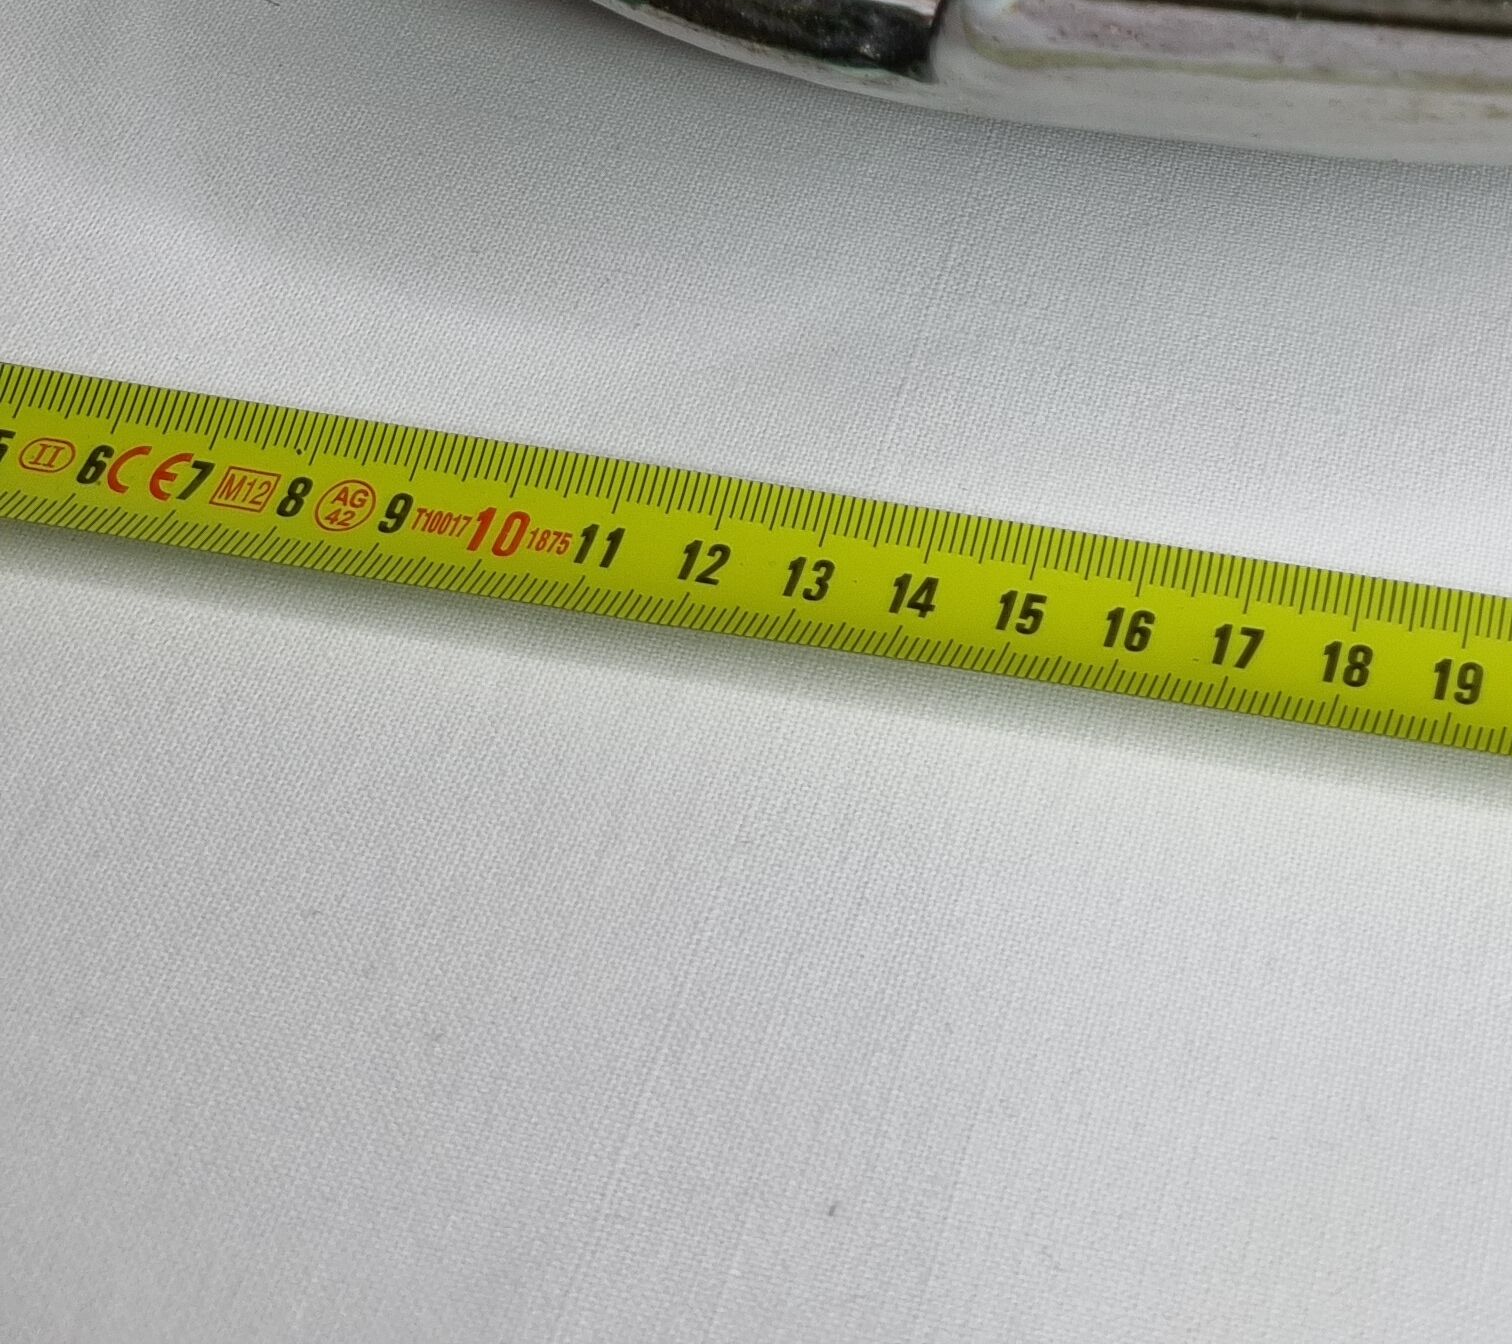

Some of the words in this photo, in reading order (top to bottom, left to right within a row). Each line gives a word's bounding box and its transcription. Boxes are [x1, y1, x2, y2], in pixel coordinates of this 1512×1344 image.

[218, 473, 272, 506] M12
[332, 486, 370, 509] AG
[324, 509, 356, 527] 42
[526, 527, 573, 555] 1875
[76, 444, 115, 485] 6
[176, 459, 216, 501] 7
[276, 476, 314, 518] 8
[378, 492, 414, 534] 9
[466, 506, 531, 558] 10
[573, 523, 626, 569] 11
[677, 539, 731, 586] 12
[782, 556, 836, 602] 13
[888, 573, 939, 619] 14
[995, 590, 1048, 636] 15
[1103, 607, 1156, 653] 16
[1211, 624, 1265, 669] 17
[1321, 641, 1373, 689] 18
[1432, 658, 1484, 706] 19
